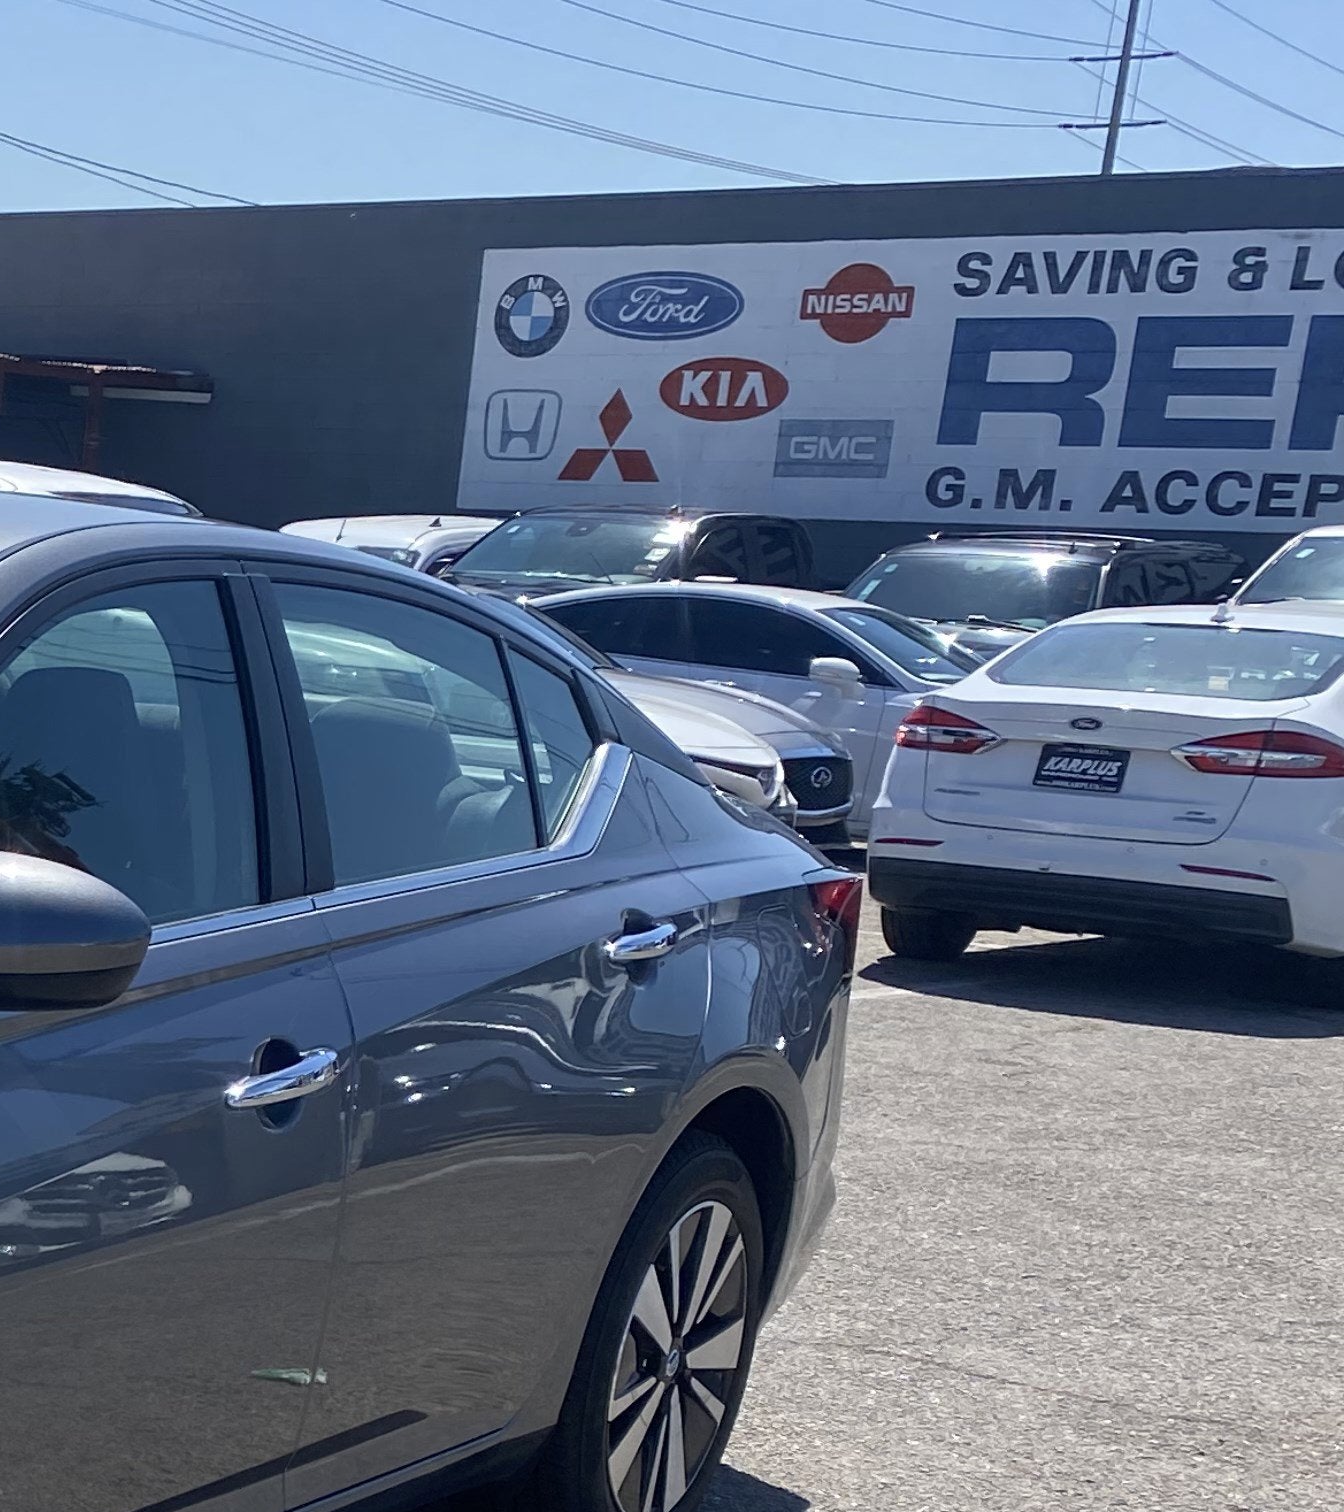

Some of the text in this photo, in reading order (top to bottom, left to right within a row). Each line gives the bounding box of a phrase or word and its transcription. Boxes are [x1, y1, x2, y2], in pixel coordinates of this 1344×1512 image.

[953, 245, 1344, 298] SAVING & L
[500, 276, 569, 310] BMW
[618, 284, 710, 323] Ford
[806, 291, 909, 315] NISSAN
[678, 369, 769, 408] KIA
[789, 435, 878, 461] GMC
[924, 465, 1344, 519] G.M. ACCEP
[1043, 756, 1123, 776] KARPLUS
